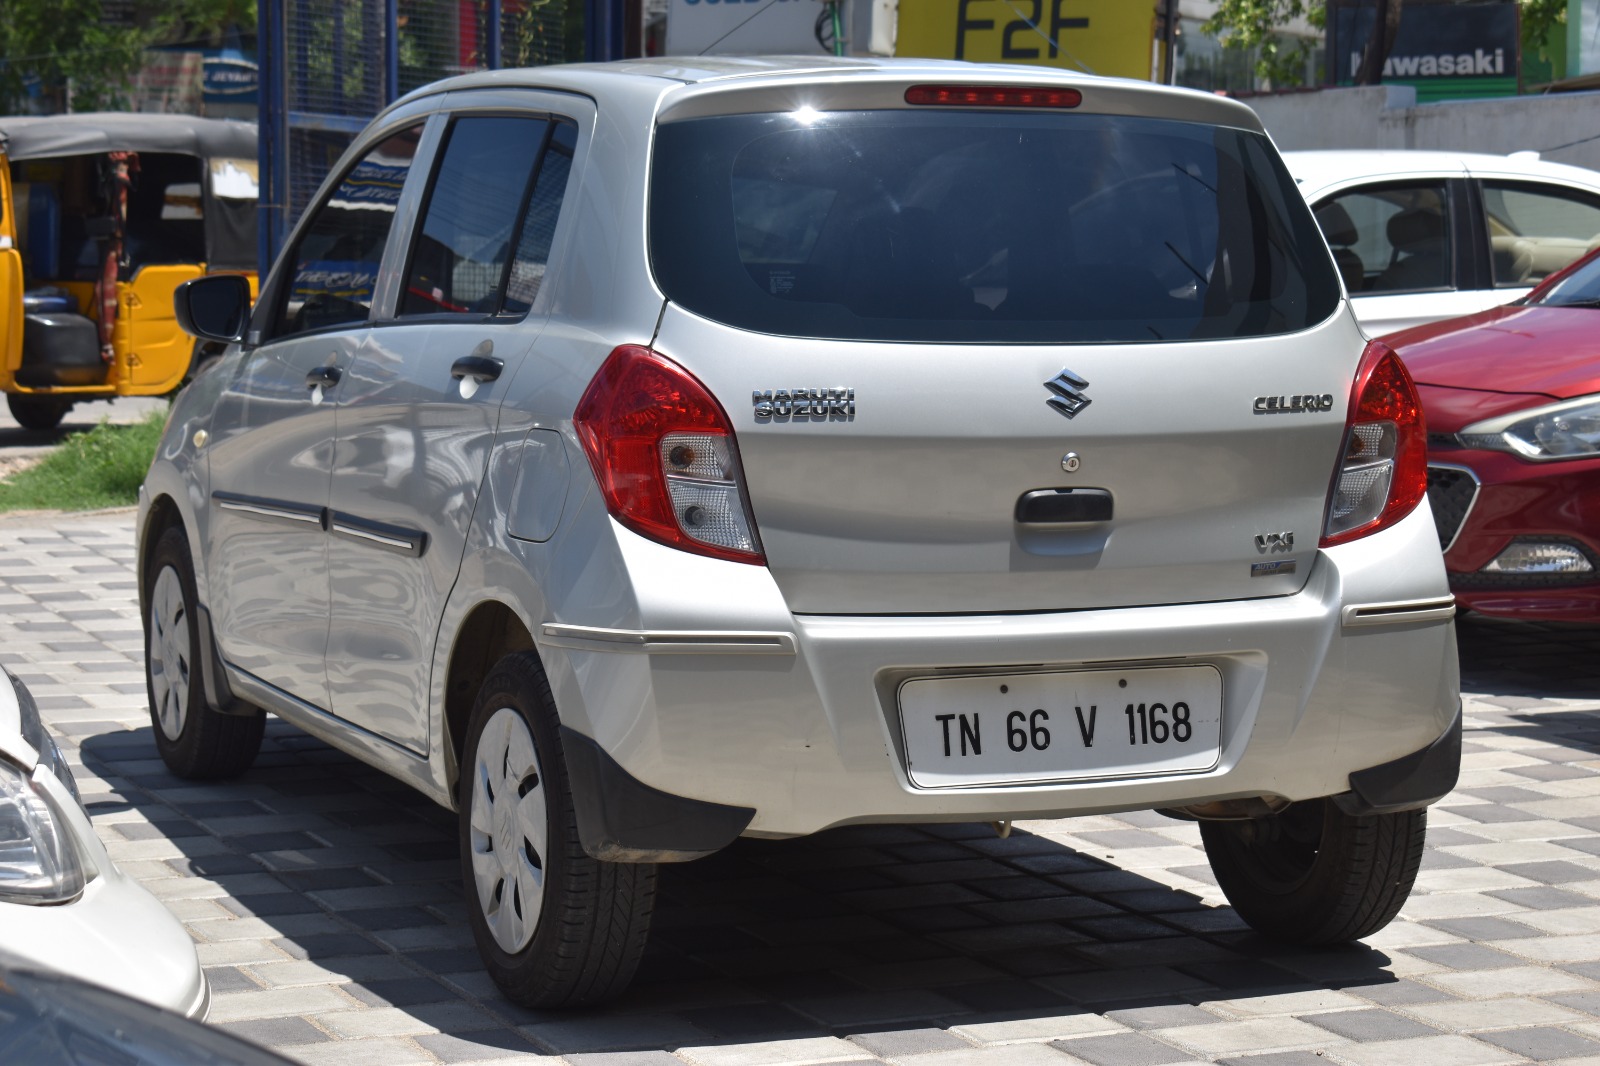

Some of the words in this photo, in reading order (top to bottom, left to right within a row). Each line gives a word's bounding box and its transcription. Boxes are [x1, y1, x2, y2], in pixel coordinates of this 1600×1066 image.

[955, 0, 1089, 60] F2F
[752, 387, 855, 403] MARUTI
[1253, 394, 1333, 413] CELERIO
[754, 401, 855, 420] SUZUKI
[935, 713, 982, 757] TN
[1007, 709, 1051, 752] 66
[1075, 706, 1097, 747] V
[1125, 702, 1193, 745] 1168
